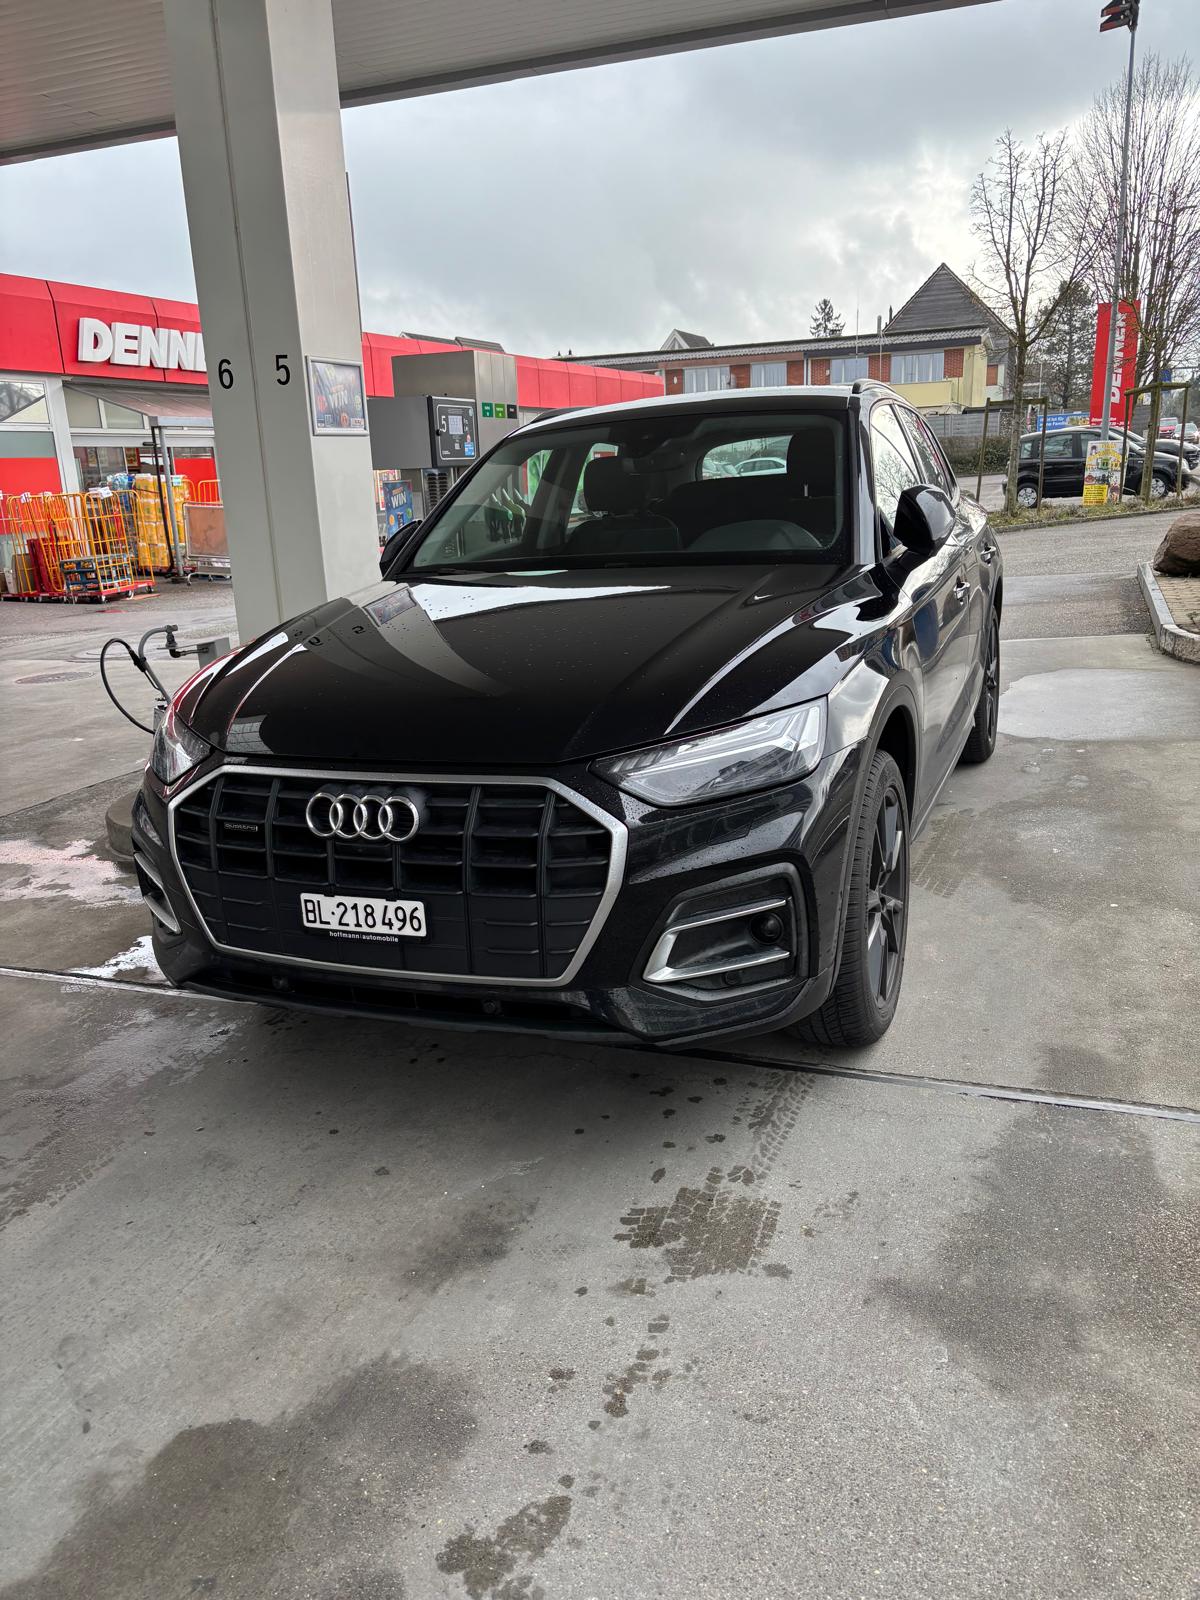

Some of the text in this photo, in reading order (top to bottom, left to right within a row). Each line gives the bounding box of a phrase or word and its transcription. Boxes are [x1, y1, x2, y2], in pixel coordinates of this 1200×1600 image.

[218, 358, 234, 389] 6
[275, 354, 291, 385] 5
[440, 415, 447, 433] 5
[391, 491, 407, 509] WIN
[362, 934, 399, 943] automobile
